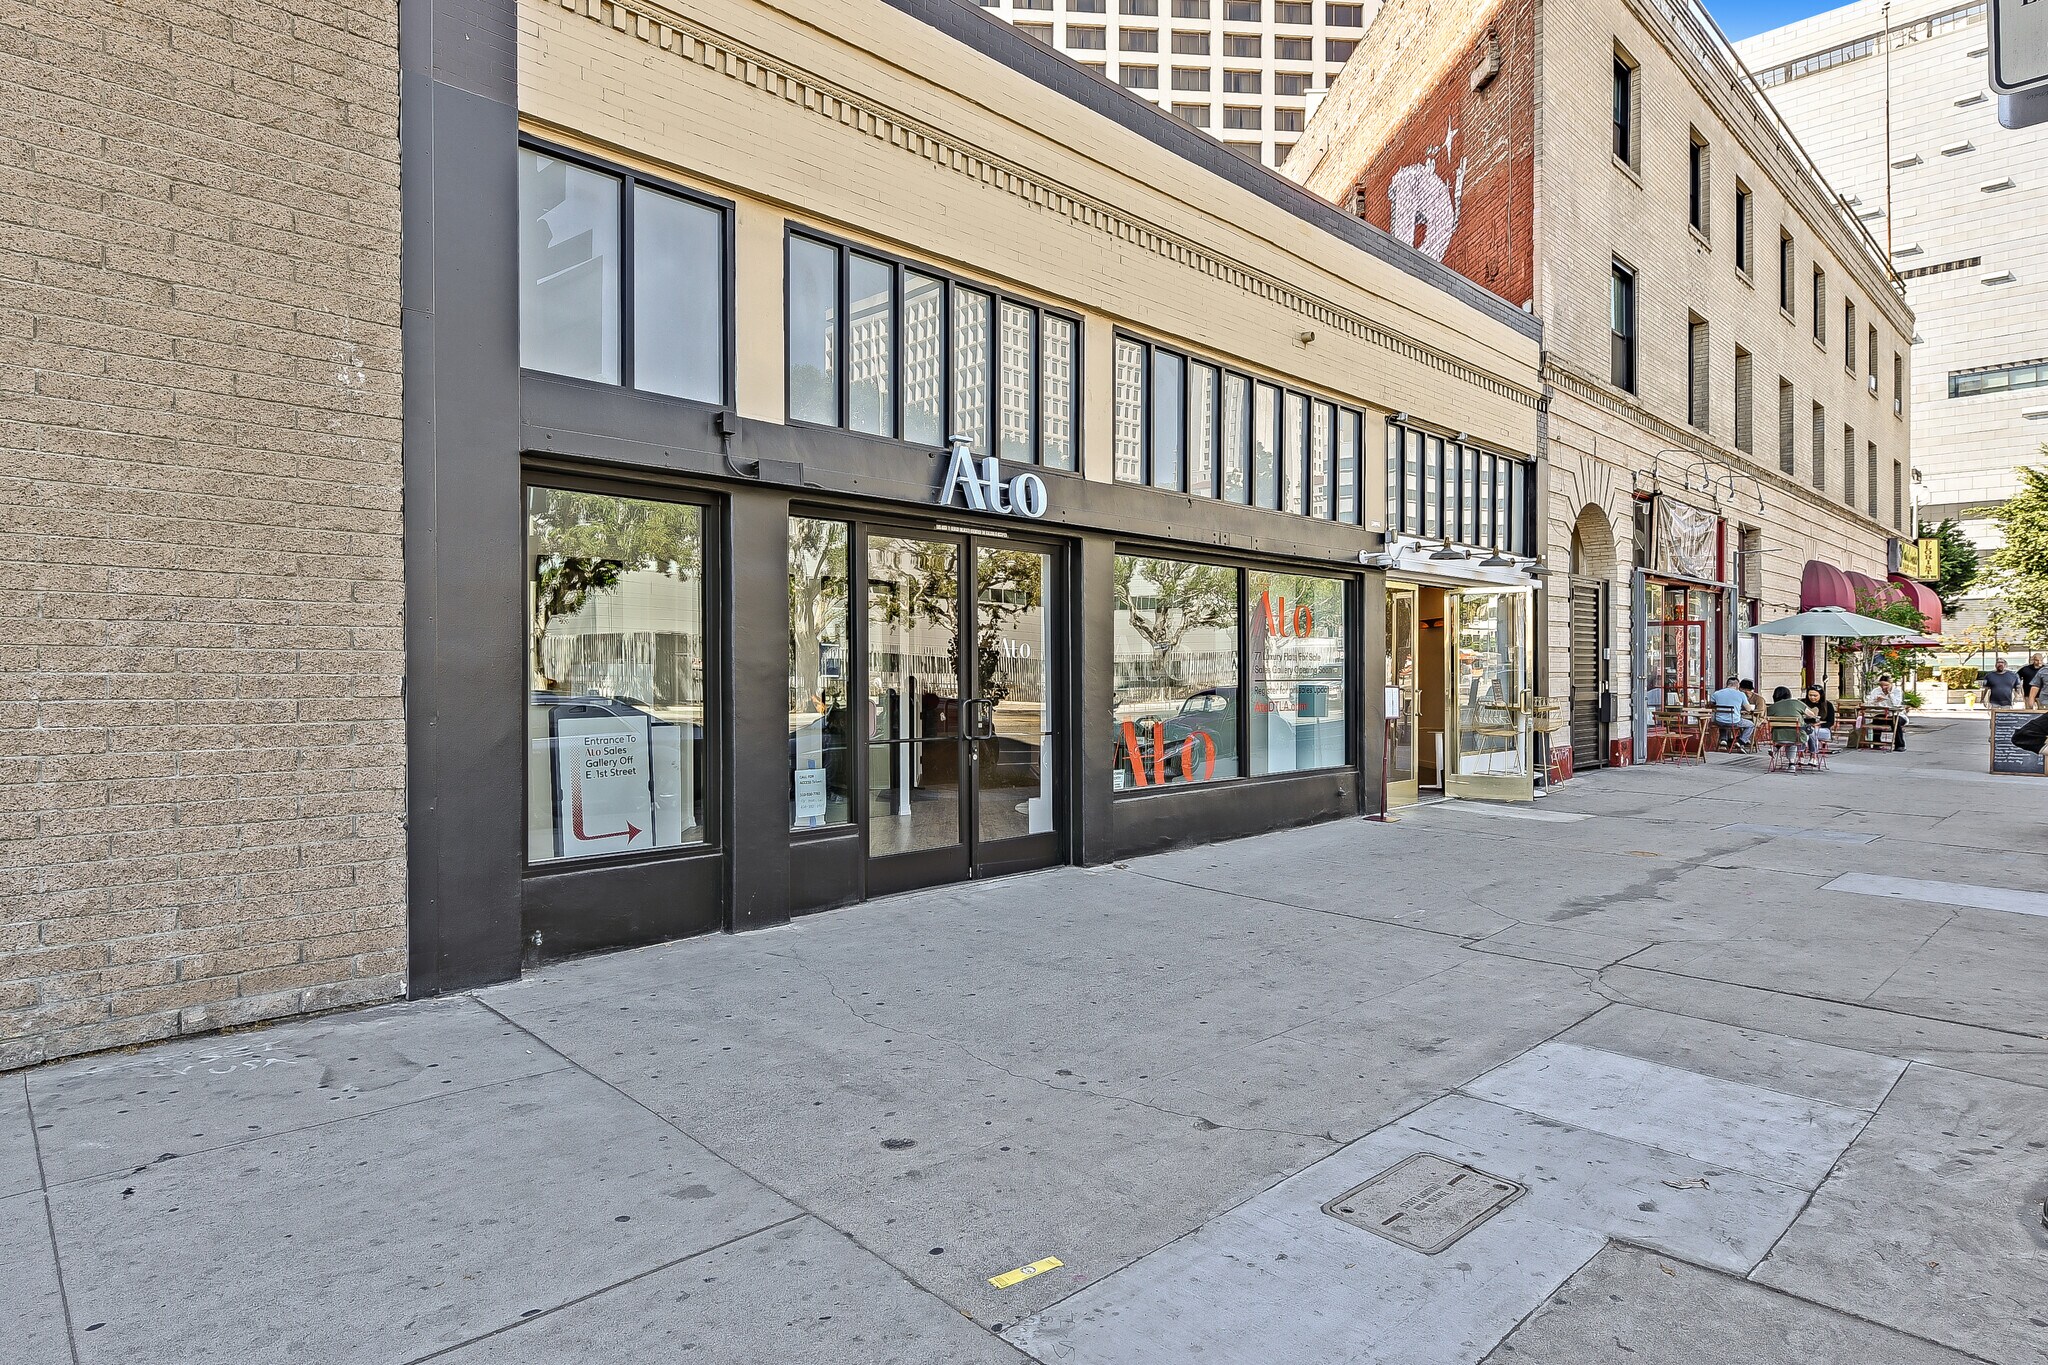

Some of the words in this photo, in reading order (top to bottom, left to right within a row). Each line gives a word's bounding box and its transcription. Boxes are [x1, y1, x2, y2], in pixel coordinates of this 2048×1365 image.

[1263, 651, 1282, 662] Luxury
[1254, 664, 1270, 674] Sales
[1294, 665, 1318, 676] Opening
[1254, 686, 1278, 696] Register
[1279, 686, 1288, 695] for
[584, 737, 624, 745] Entrance
[603, 746, 627, 755] Sales
[585, 759, 617, 767] Gallery
[619, 756, 633, 765] Off
[596, 770, 608, 778] 1st
[610, 768, 636, 776] Street
